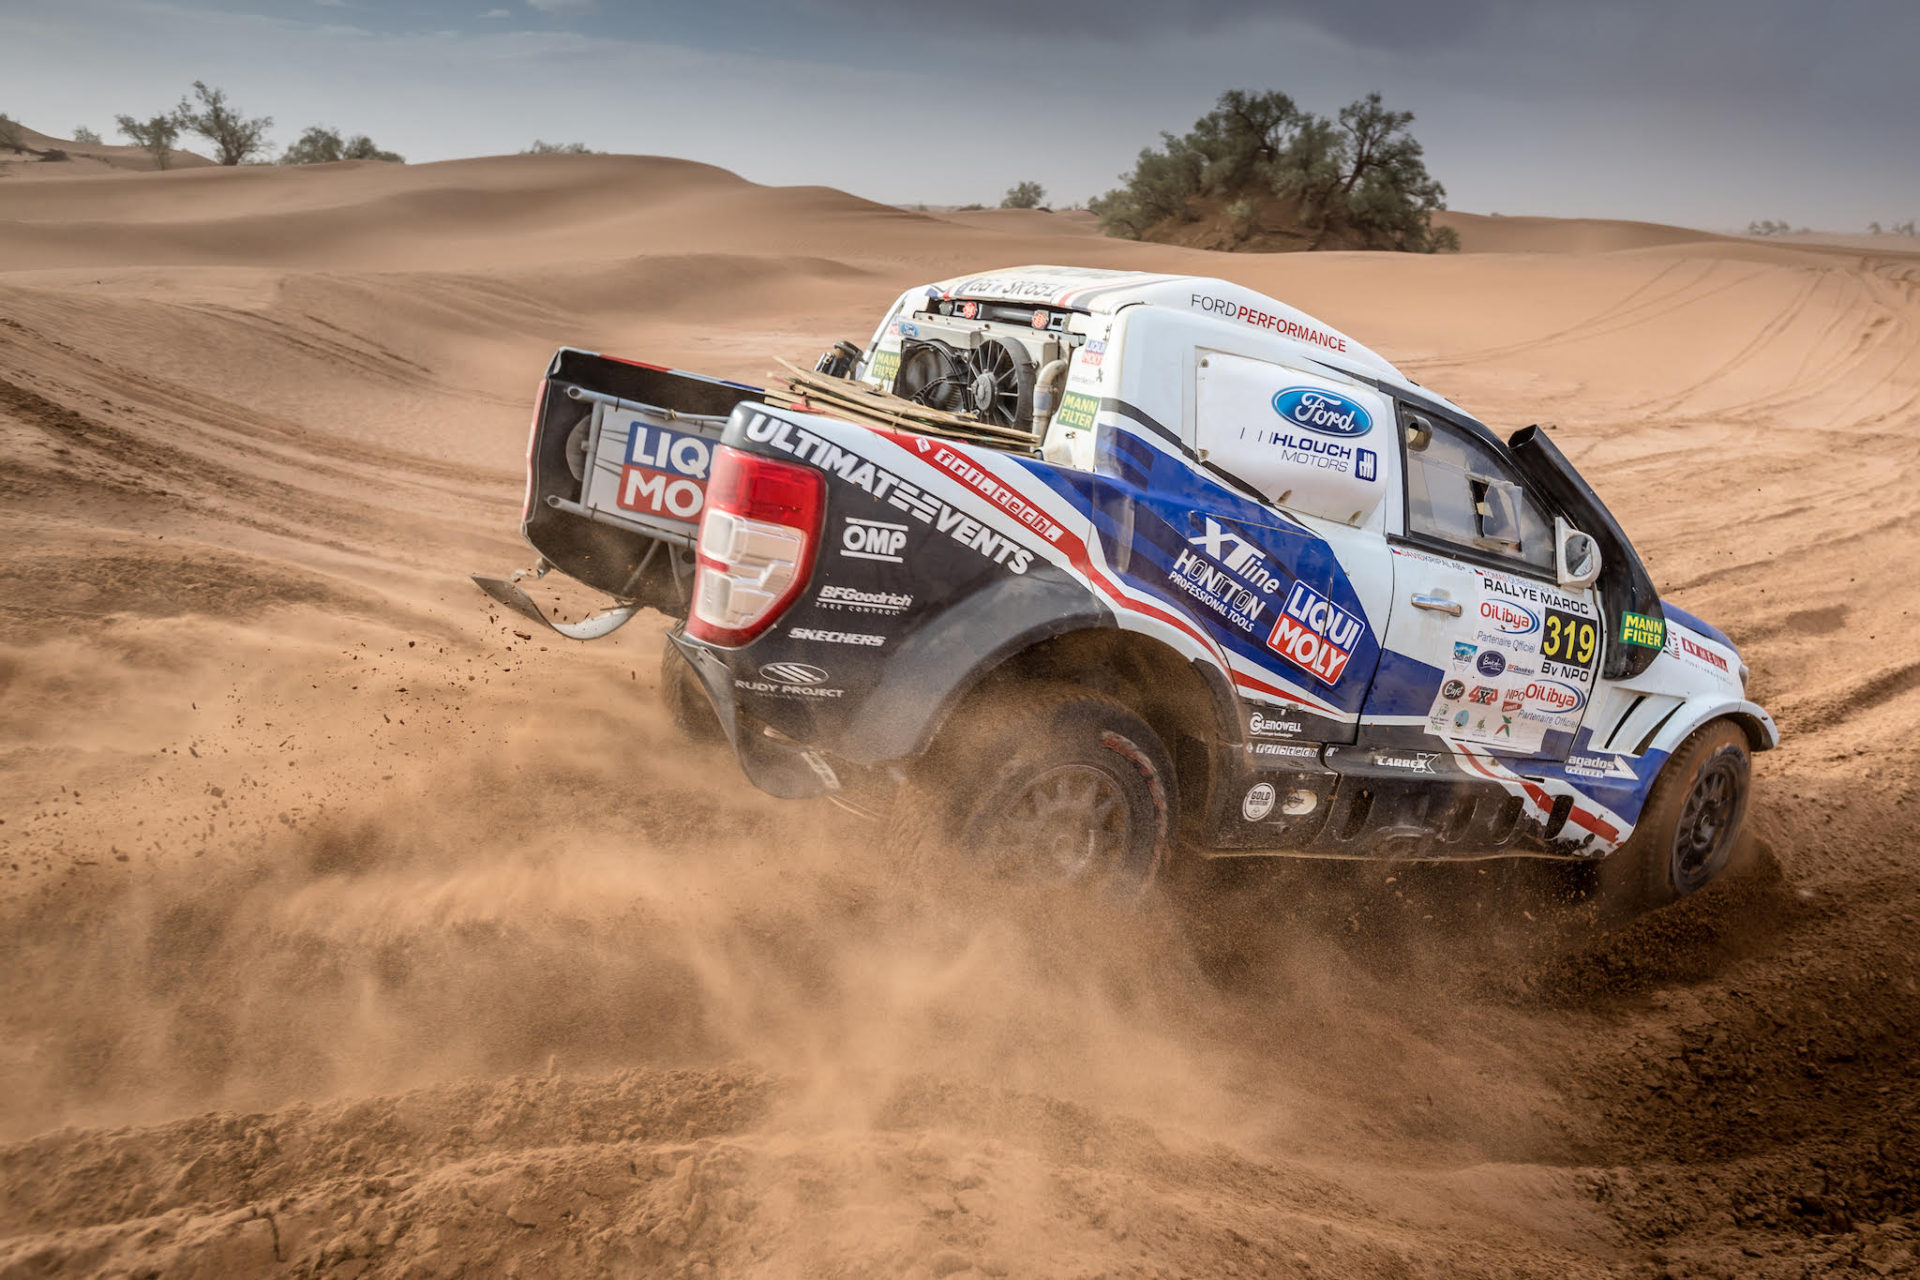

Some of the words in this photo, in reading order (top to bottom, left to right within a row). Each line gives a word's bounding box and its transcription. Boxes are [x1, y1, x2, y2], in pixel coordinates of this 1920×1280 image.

[1191, 294, 1237, 317] FORD
[1237, 306, 1347, 352] PERFORMANCE
[1063, 394, 1097, 414] MANN
[1295, 392, 1355, 432] Ford
[1059, 408, 1093, 428] FILTER
[632, 426, 716, 479] LIQ
[1273, 433, 1351, 460] HLOUCH
[1281, 450, 1348, 473] MOTORS
[624, 469, 703, 517] MO
[843, 525, 907, 556] OMP
[1173, 548, 1267, 621] HONITON
[816, 602, 843, 611] TAKE
[819, 585, 913, 607] BFGoodrich
[1169, 572, 1228, 617] PROFESSIONAL
[1227, 611, 1255, 632] TOOLS
[1484, 578, 1538, 602] RALLYE
[1541, 592, 1589, 615] MAROC
[1287, 586, 1360, 649] LIQUI
[1625, 615, 1663, 634] MANN
[789, 627, 886, 647] SKECHERS
[1477, 630, 1511, 648] Partenaire
[1543, 615, 1596, 664] 319
[1623, 628, 1662, 647] FILTER
[1272, 618, 1347, 679] MOLY
[1560, 666, 1589, 682] NPO
[735, 679, 779, 693] RUDY
[782, 684, 844, 698] PROJECT
[1505, 688, 1525, 702] NPO
[1518, 709, 1553, 724] Partenaire
[1251, 791, 1271, 801] GOLD
